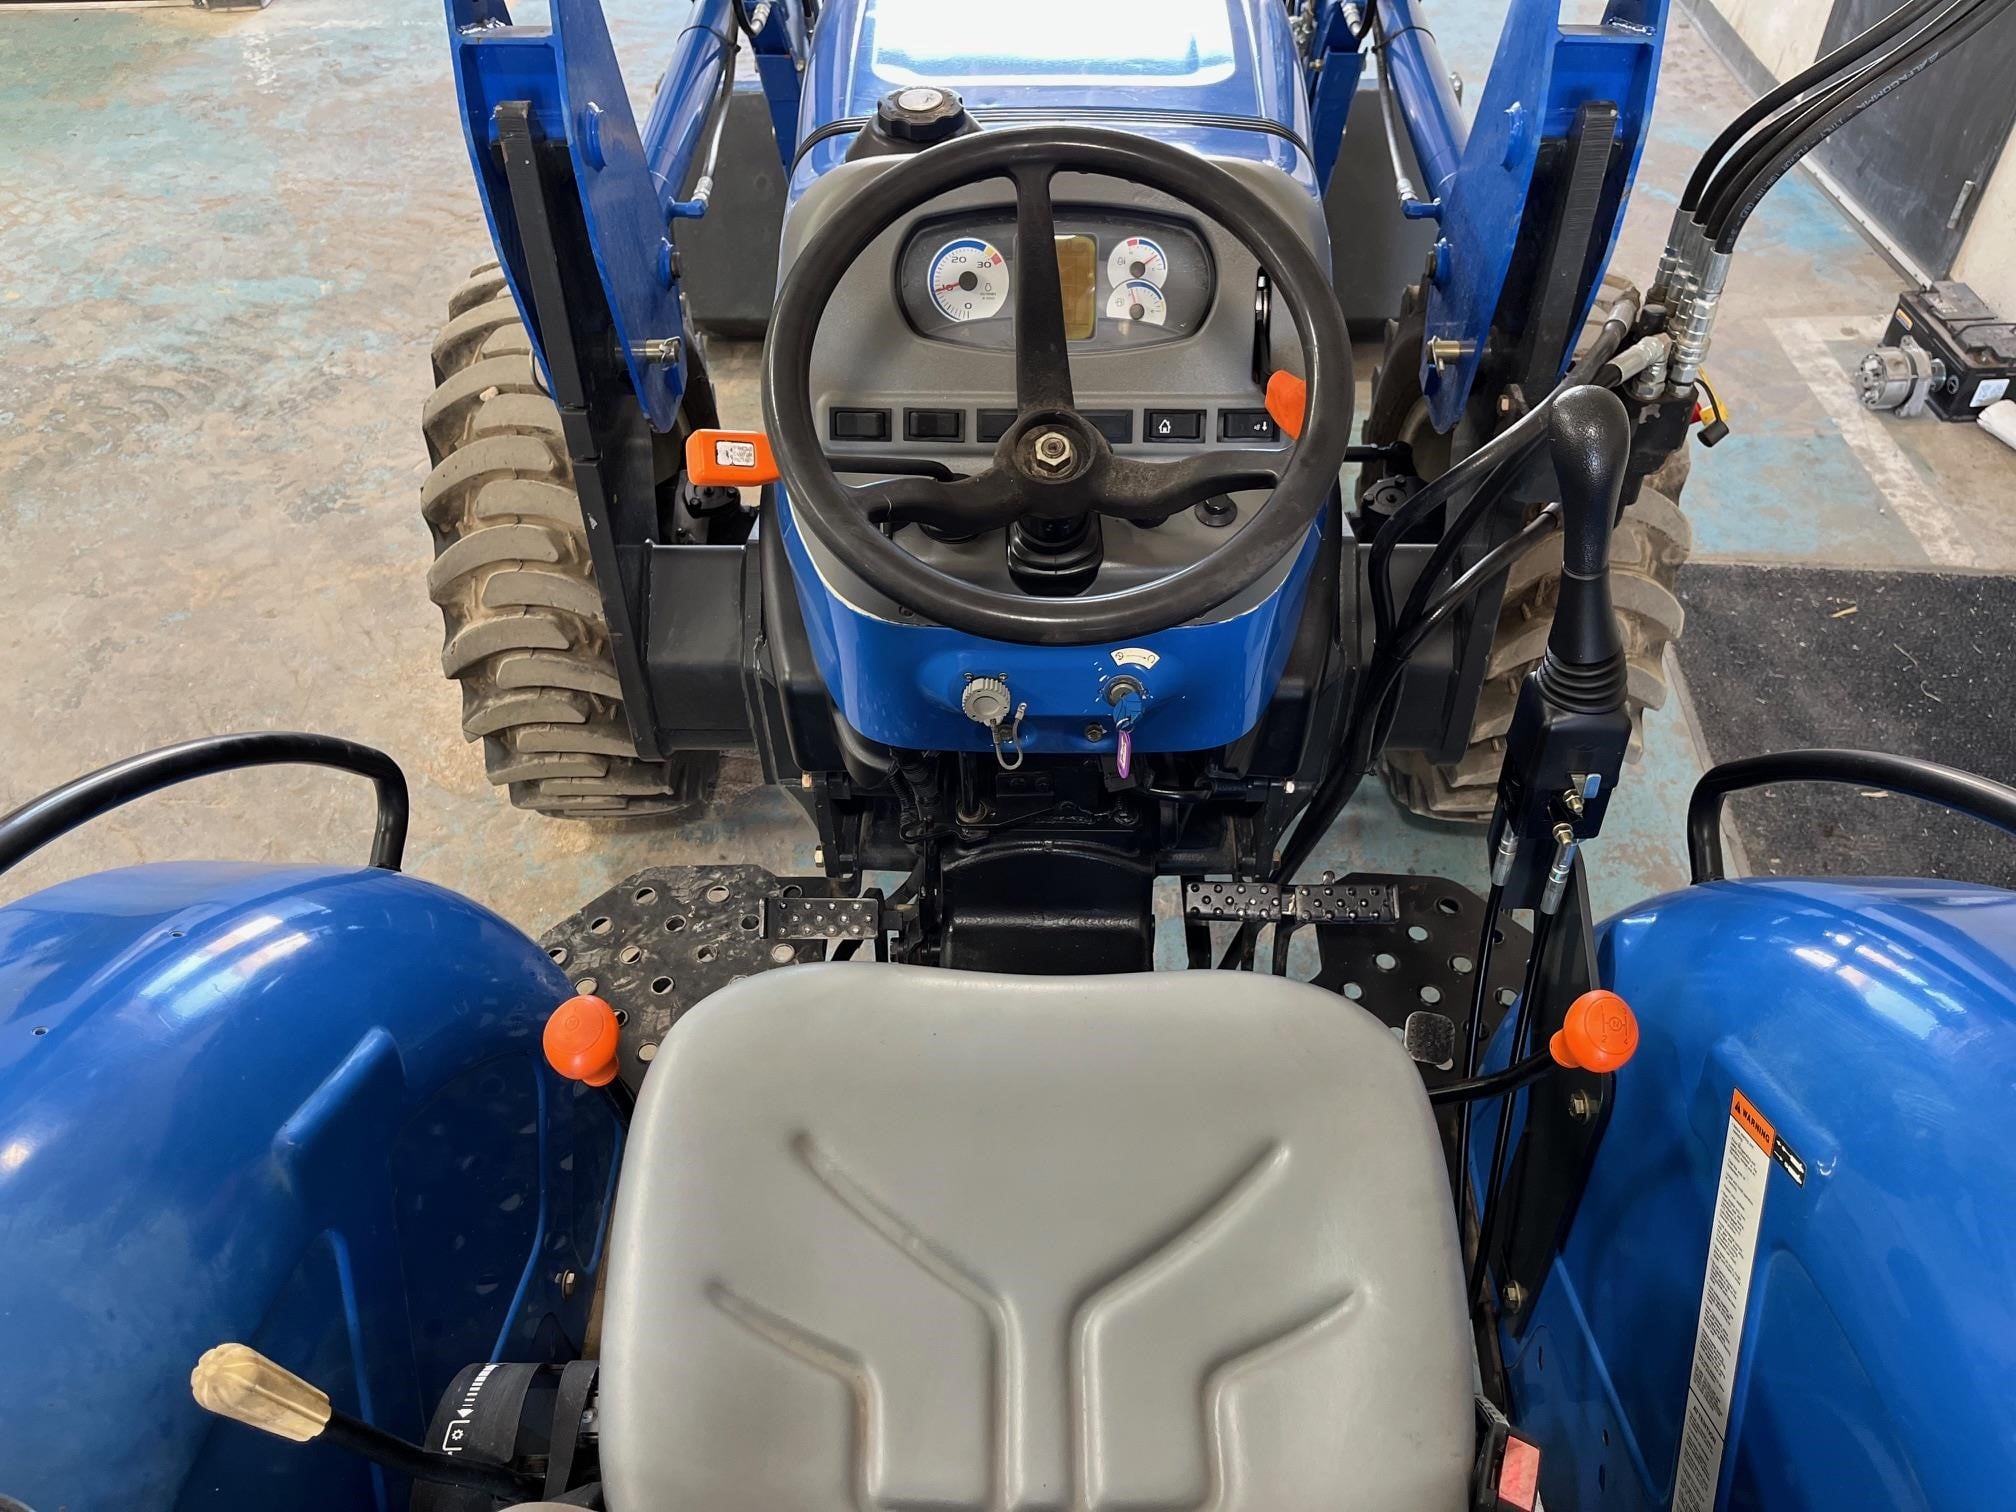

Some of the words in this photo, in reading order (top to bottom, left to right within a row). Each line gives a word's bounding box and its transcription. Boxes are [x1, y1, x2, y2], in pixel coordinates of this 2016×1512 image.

[951, 256, 967, 264] 20
[977, 261, 992, 269] 30
[964, 302, 972, 310] 0
[1741, 1110, 1770, 1144] WARNING
